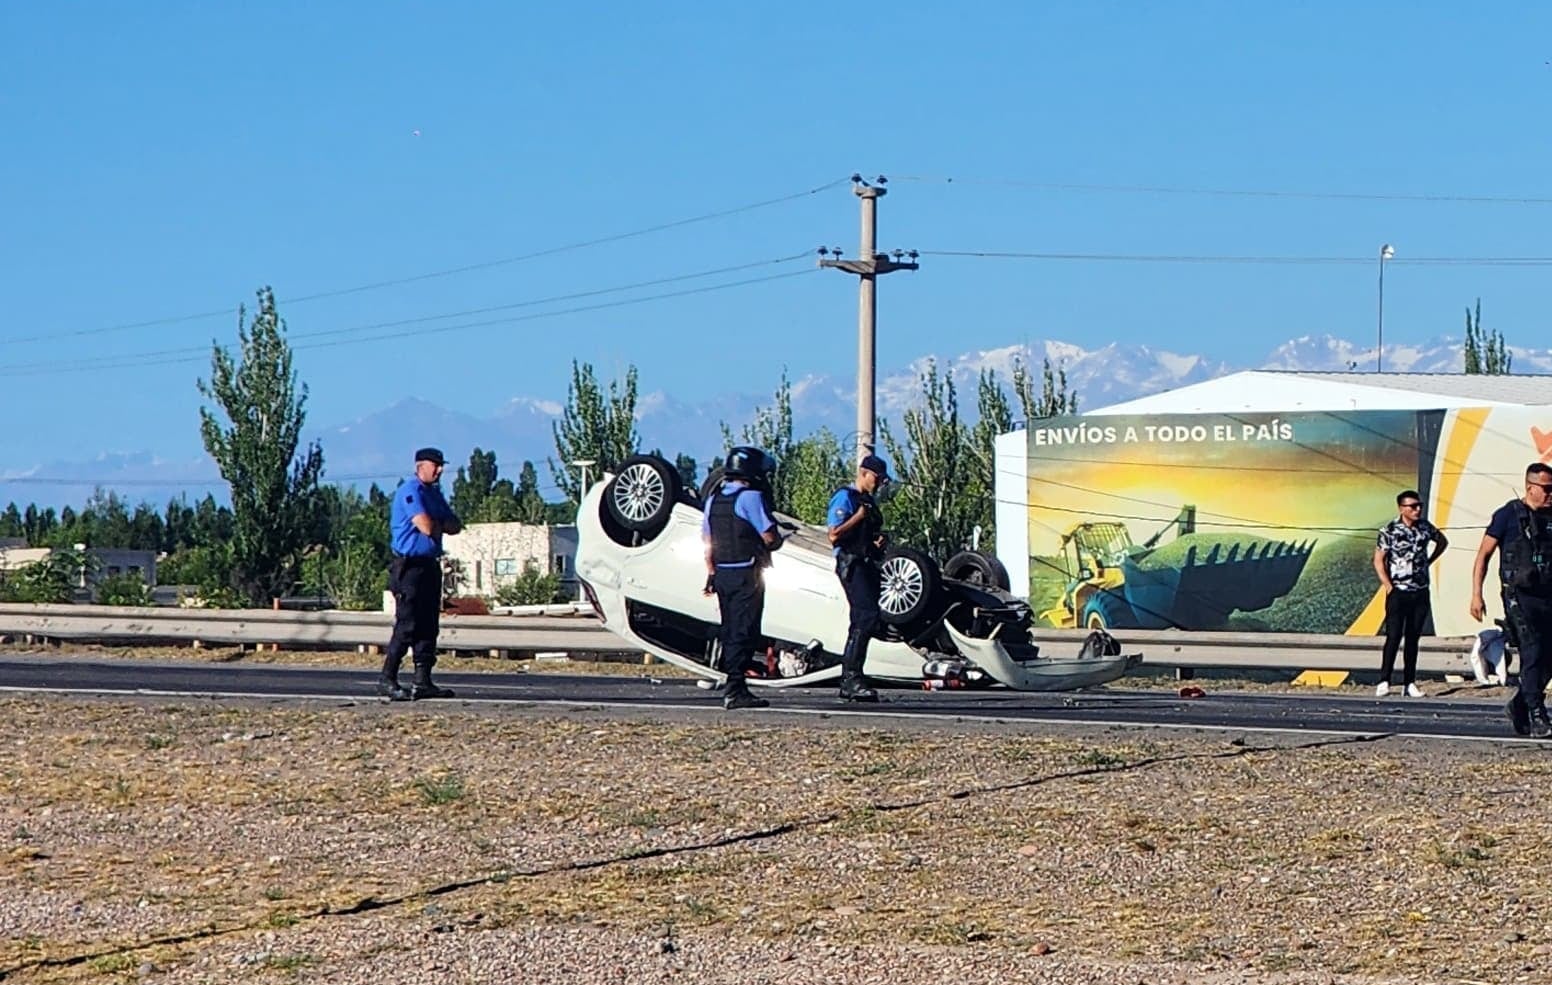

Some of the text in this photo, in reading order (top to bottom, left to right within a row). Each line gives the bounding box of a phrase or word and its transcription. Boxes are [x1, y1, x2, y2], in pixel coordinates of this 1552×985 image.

[1035, 418, 1293, 445] ENVÍOS A TODO EL PAÍS
